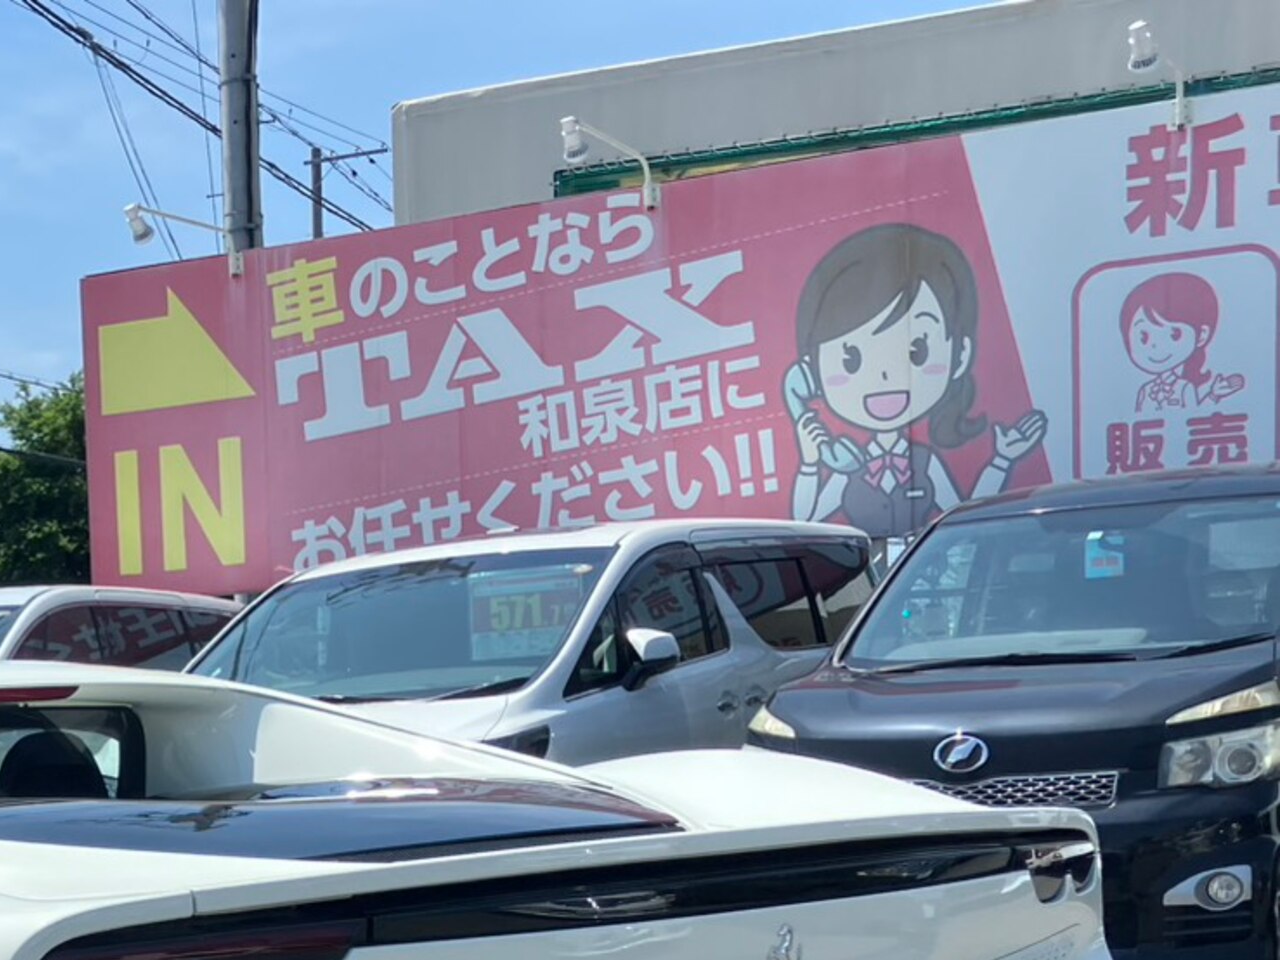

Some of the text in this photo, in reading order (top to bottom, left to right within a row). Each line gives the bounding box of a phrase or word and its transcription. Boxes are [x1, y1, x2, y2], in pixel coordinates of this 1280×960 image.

[1124, 112, 1280, 237] 新
[267, 193, 655, 343] 車のことなら
[275, 250, 755, 441] TAX
[520, 356, 765, 458] 和泉店に
[114, 437, 246, 576] IN
[1105, 412, 1248, 475] 販売
